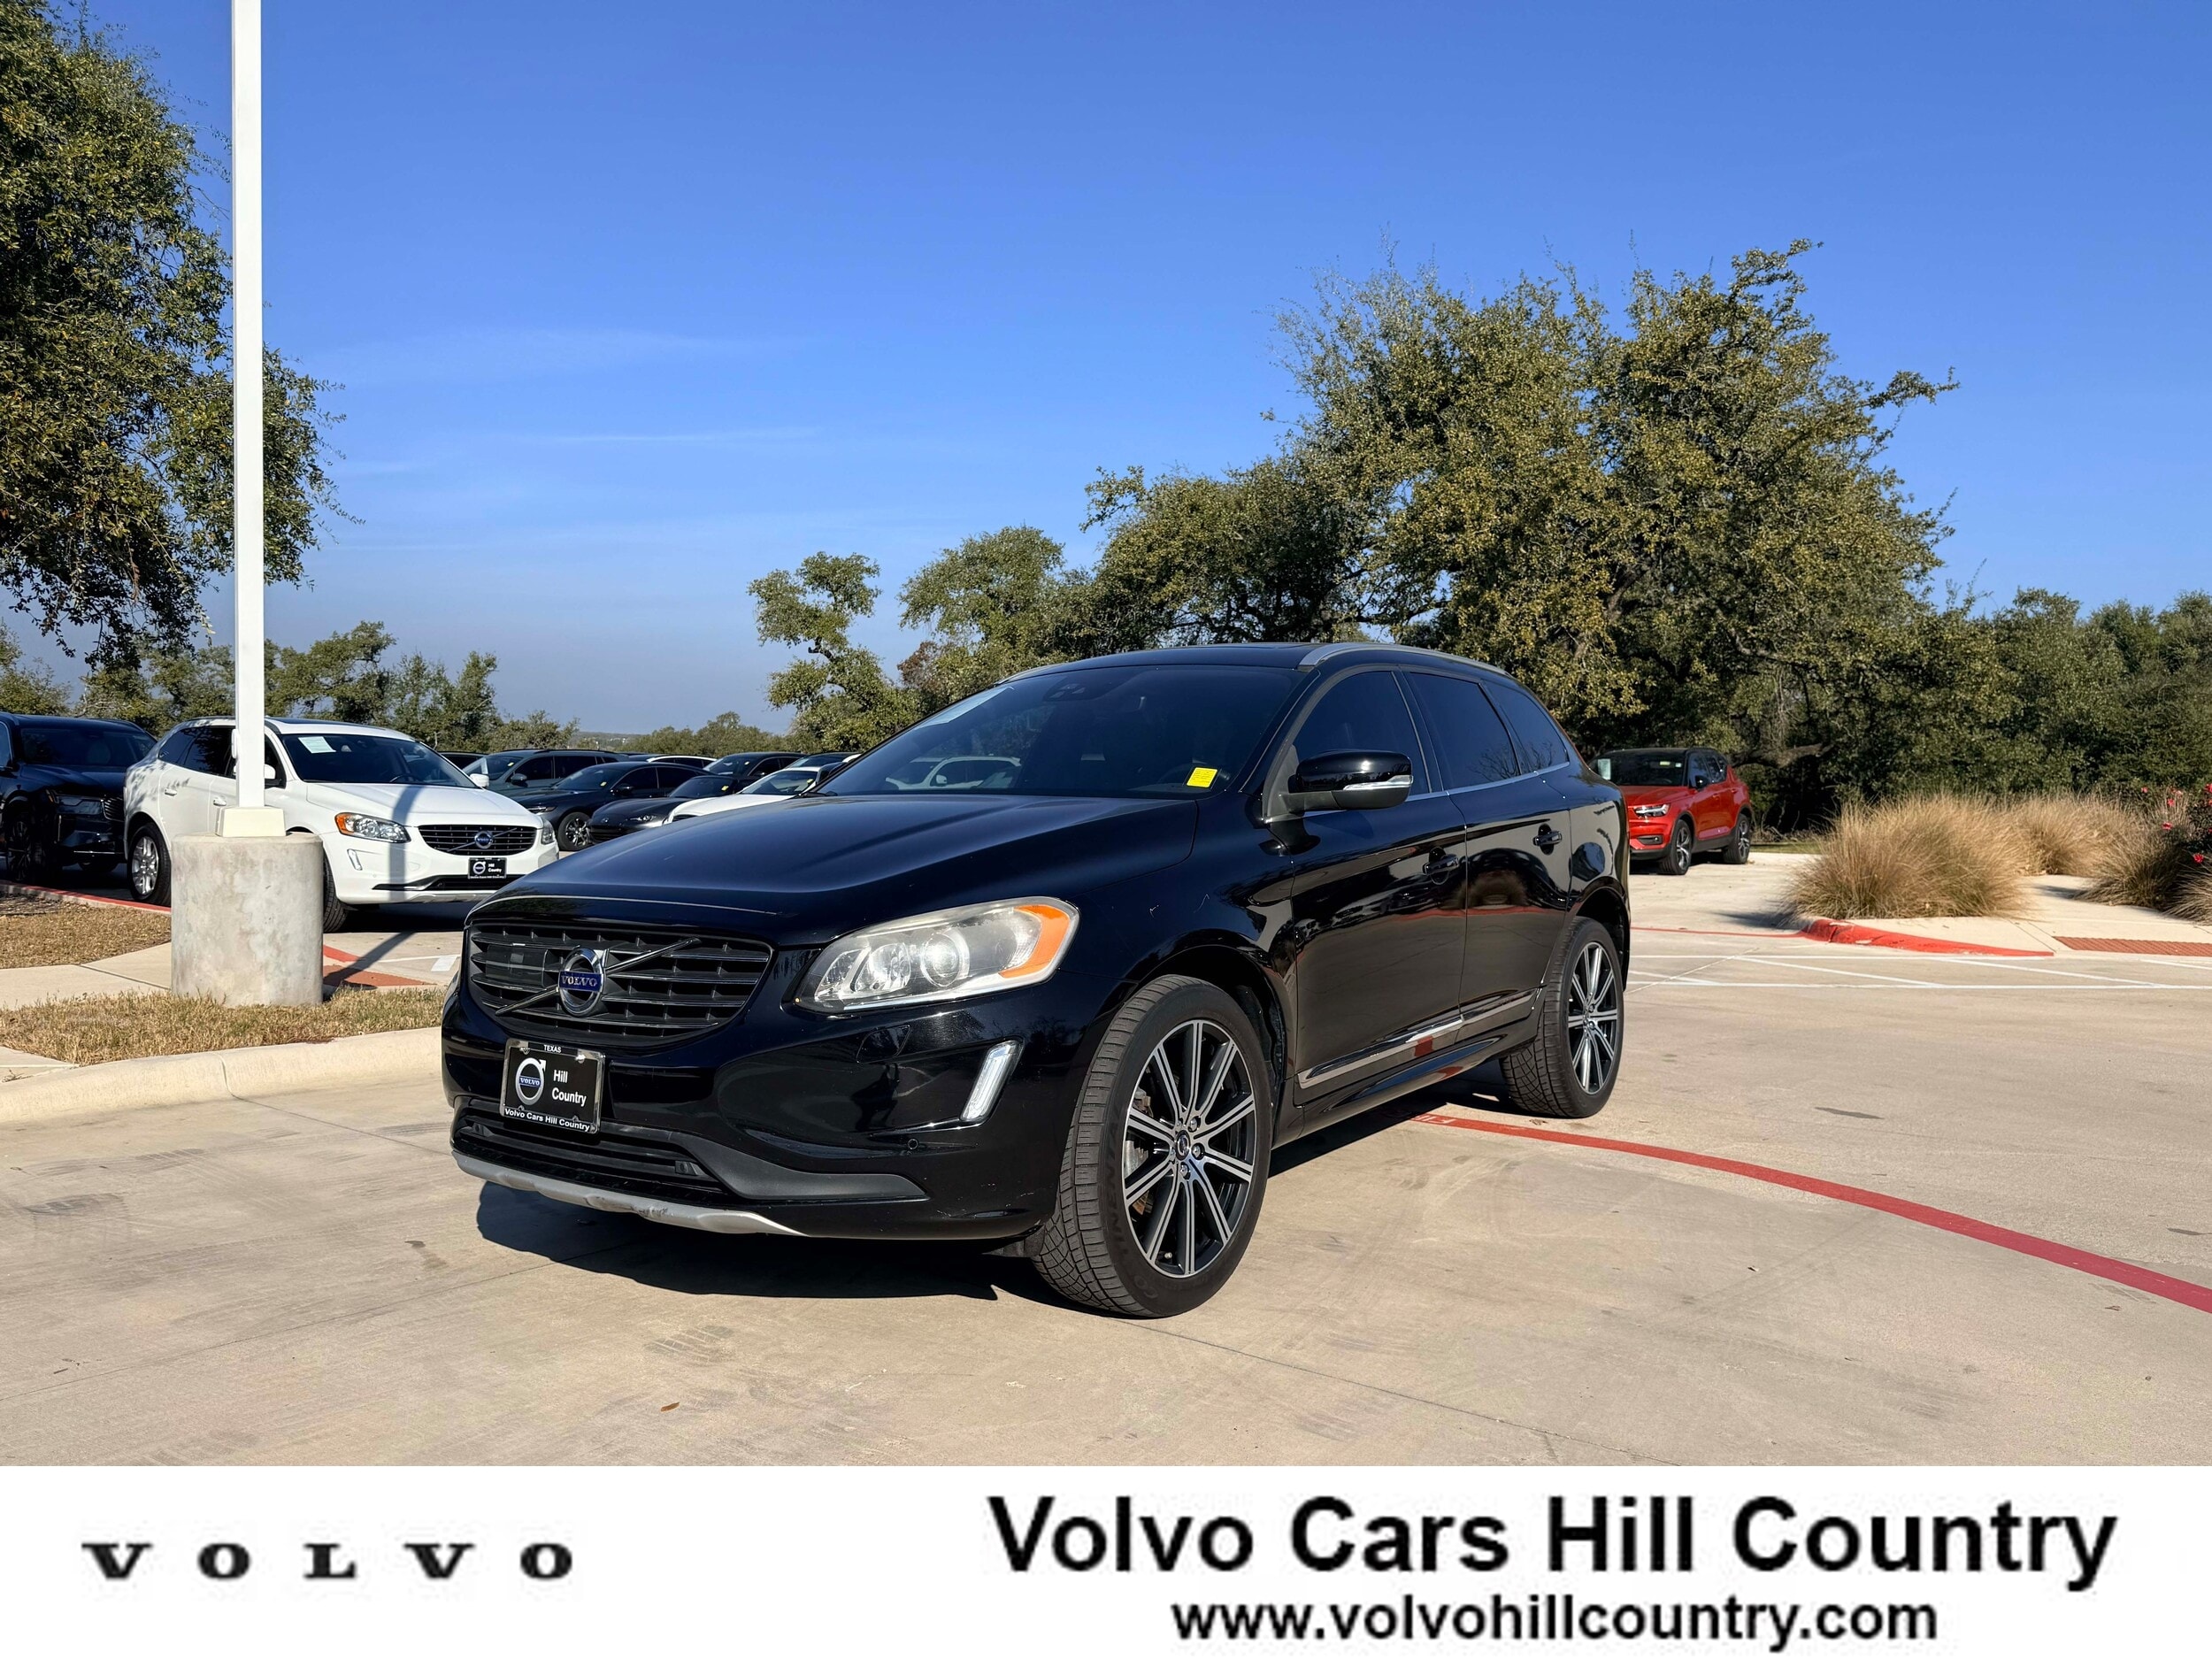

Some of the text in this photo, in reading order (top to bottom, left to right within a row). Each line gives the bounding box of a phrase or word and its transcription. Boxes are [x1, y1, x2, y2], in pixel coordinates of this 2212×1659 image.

[561, 975, 597, 987] VOLVO
[543, 1044, 562, 1053] TEXAS
[519, 1077, 541, 1086] VOLVO
[553, 1070, 568, 1083] Hill
[551, 1087, 588, 1107] Country
[504, 1108, 590, 1132] Volvo Cars Hill Country
[1106, 1105, 1159, 1300] COTINENTAL
